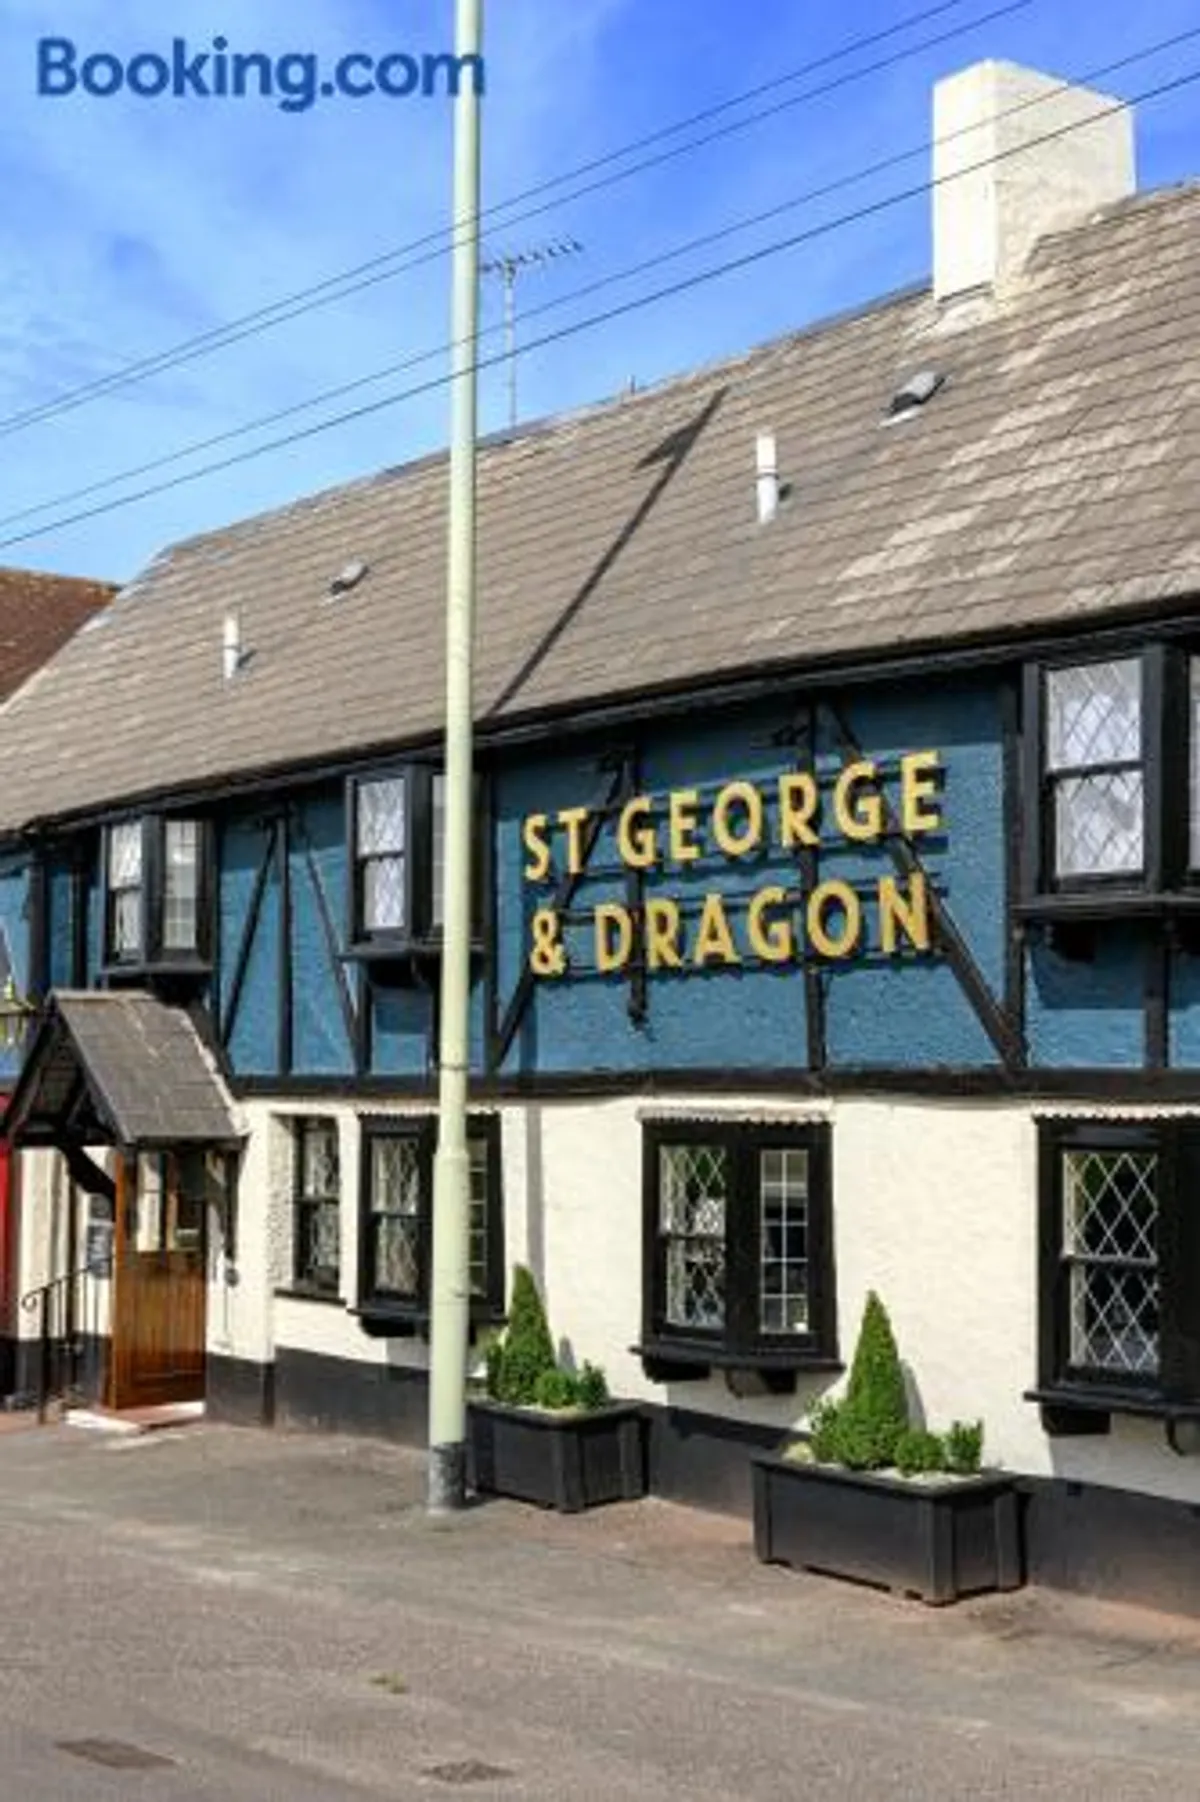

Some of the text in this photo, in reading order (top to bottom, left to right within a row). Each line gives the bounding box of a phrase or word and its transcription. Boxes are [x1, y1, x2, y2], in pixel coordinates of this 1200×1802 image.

[523, 750, 941, 881] ST GEORGE
[530, 871, 931, 975] & DRAGON
